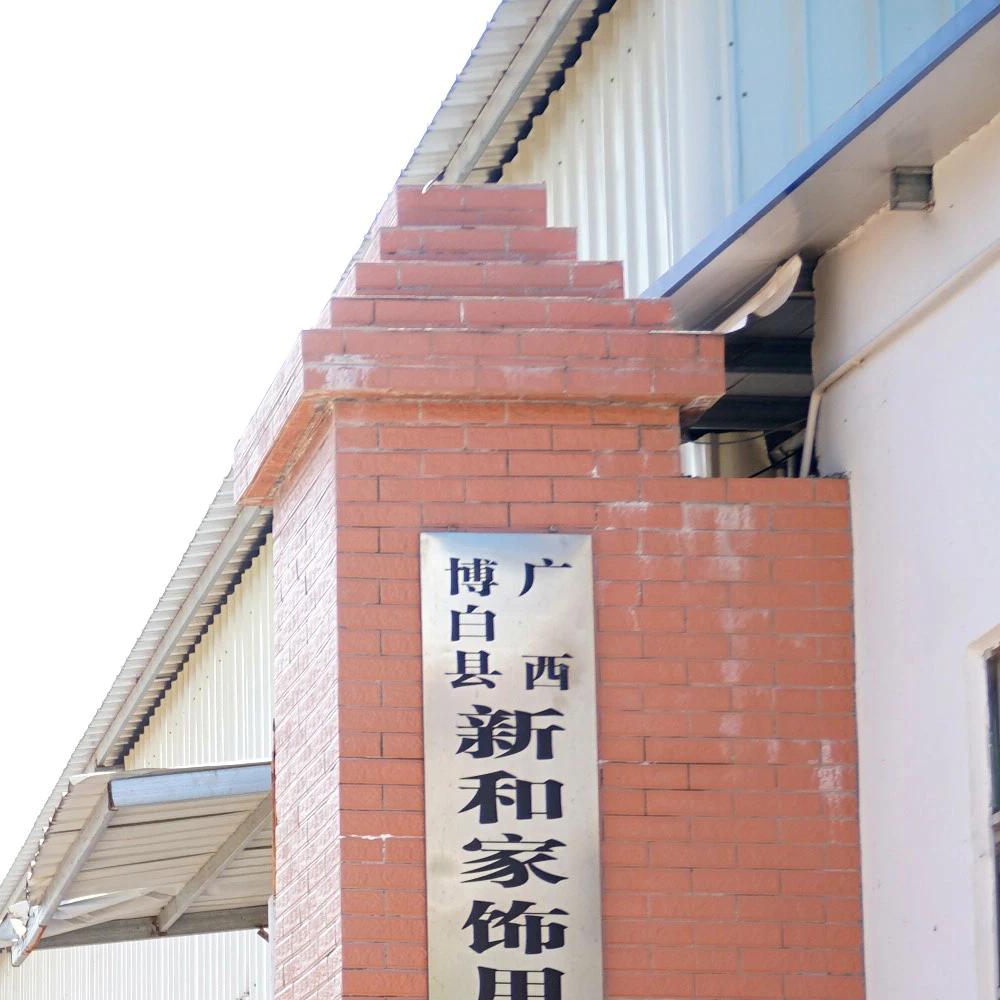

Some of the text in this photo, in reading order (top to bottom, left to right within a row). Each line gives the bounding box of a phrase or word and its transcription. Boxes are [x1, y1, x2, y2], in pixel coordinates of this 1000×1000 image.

[445, 557, 503, 689] 博白县
[518, 557, 573, 691] 广西
